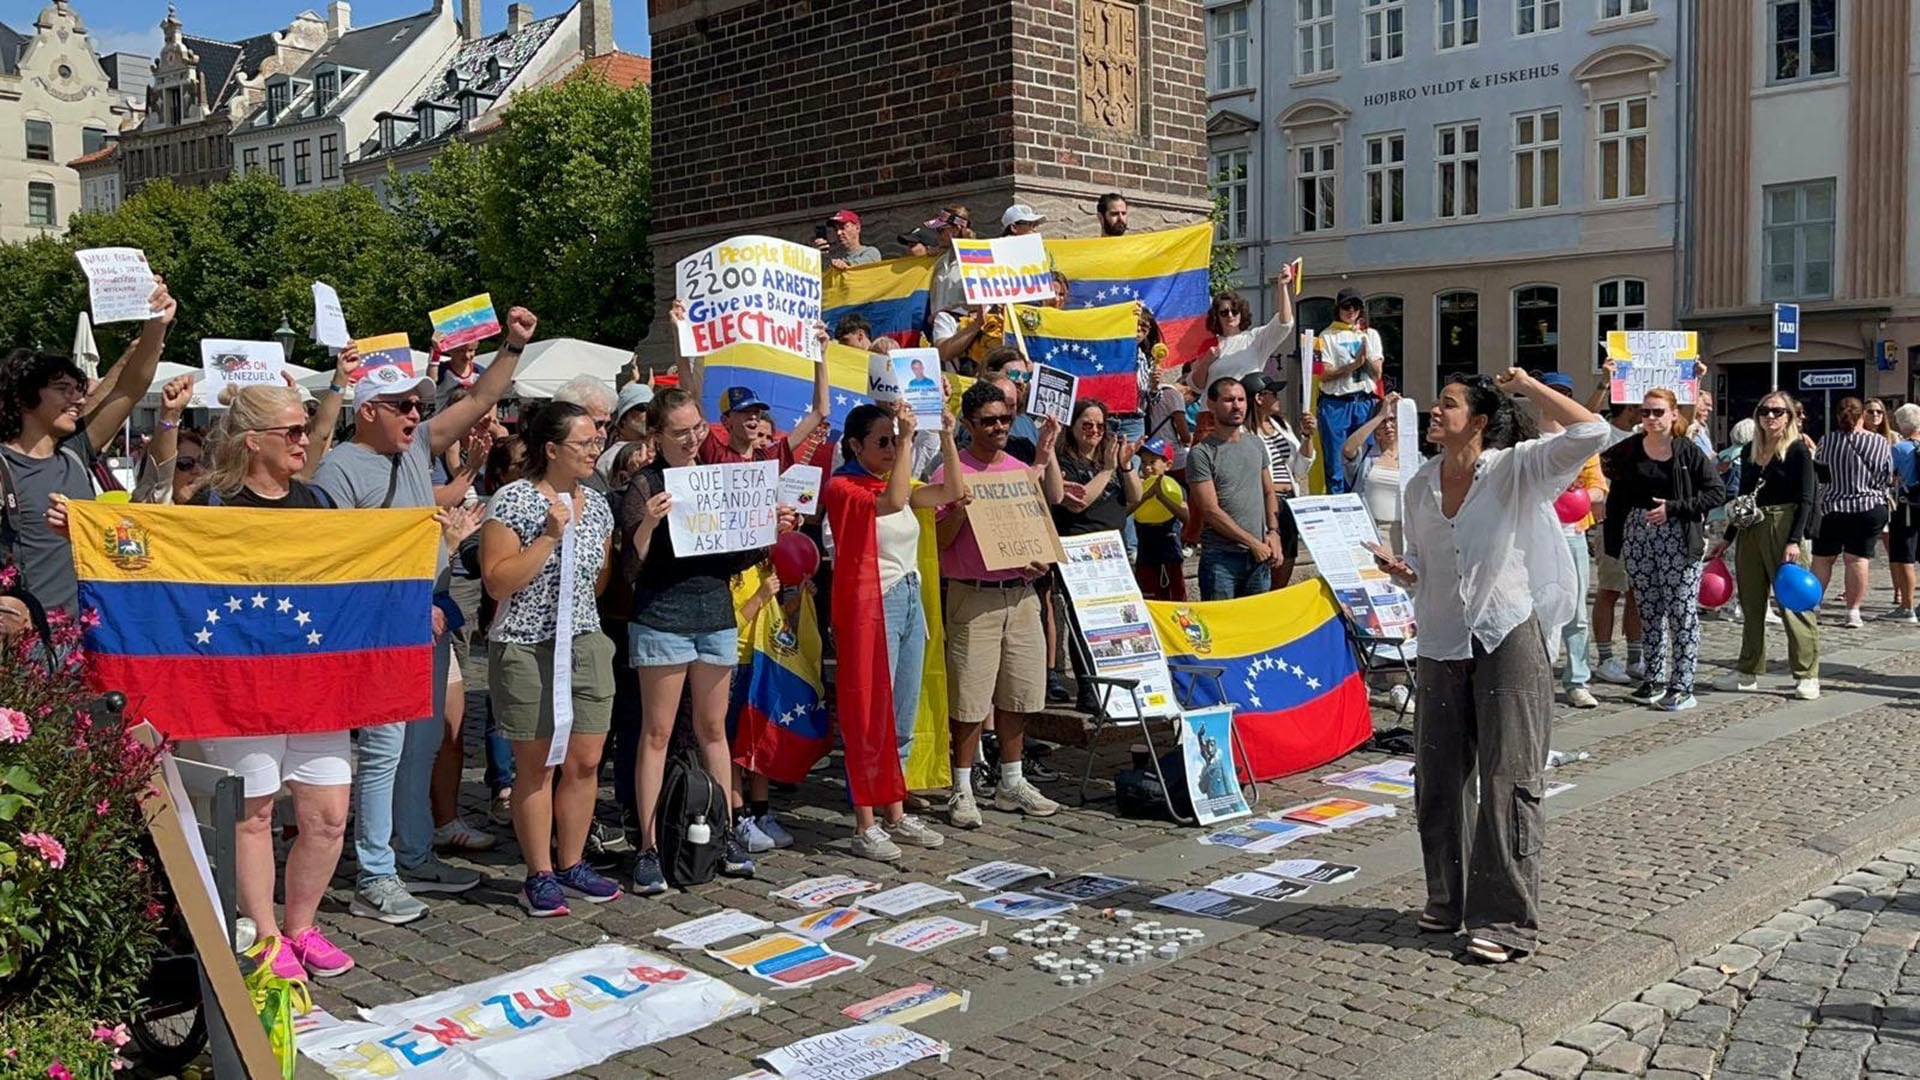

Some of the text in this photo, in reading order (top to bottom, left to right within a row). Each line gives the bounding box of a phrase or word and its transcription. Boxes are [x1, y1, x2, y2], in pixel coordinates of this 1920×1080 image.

[1364, 63, 1560, 107] HØJBRO VILDT & FISKEHUS
[683, 251, 714, 279] 24
[686, 267, 820, 300] 2200 ARRESTS
[961, 261, 1053, 299] FREEDOM
[689, 297, 740, 323] Give
[1779, 321, 1795, 334] TAXI
[1627, 331, 1687, 349] FREEDOM
[253, 361, 268, 370] ON
[1631, 353, 1655, 368] FOR
[220, 371, 276, 381] VENEZUELA
[868, 376, 901, 394] Vene
[696, 488, 778, 512] PASANDO EN
[686, 508, 774, 534] VENEZUELA
[694, 530, 757, 552] ASK US
[997, 539, 1043, 557] RIGHTS
[334, 965, 690, 1078] VENEZUELA
